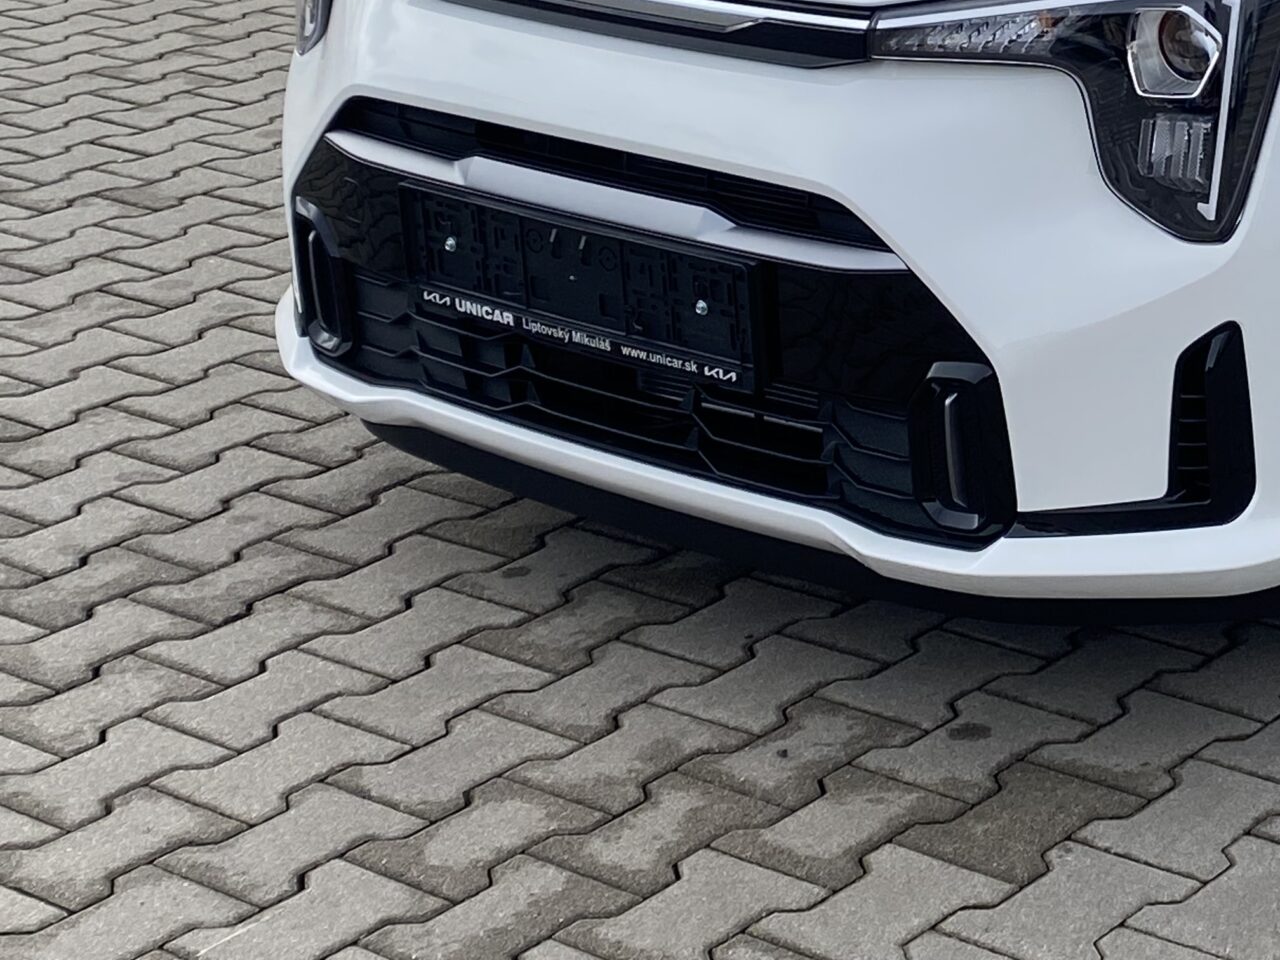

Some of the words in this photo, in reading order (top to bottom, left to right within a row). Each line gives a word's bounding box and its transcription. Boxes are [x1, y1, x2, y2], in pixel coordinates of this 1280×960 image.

[423, 290, 451, 306] KIA
[455, 297, 514, 327] UNICAR
[522, 317, 571, 343] Liptovský
[621, 345, 699, 374] www.unicar.sk
[704, 365, 737, 382] KIA
